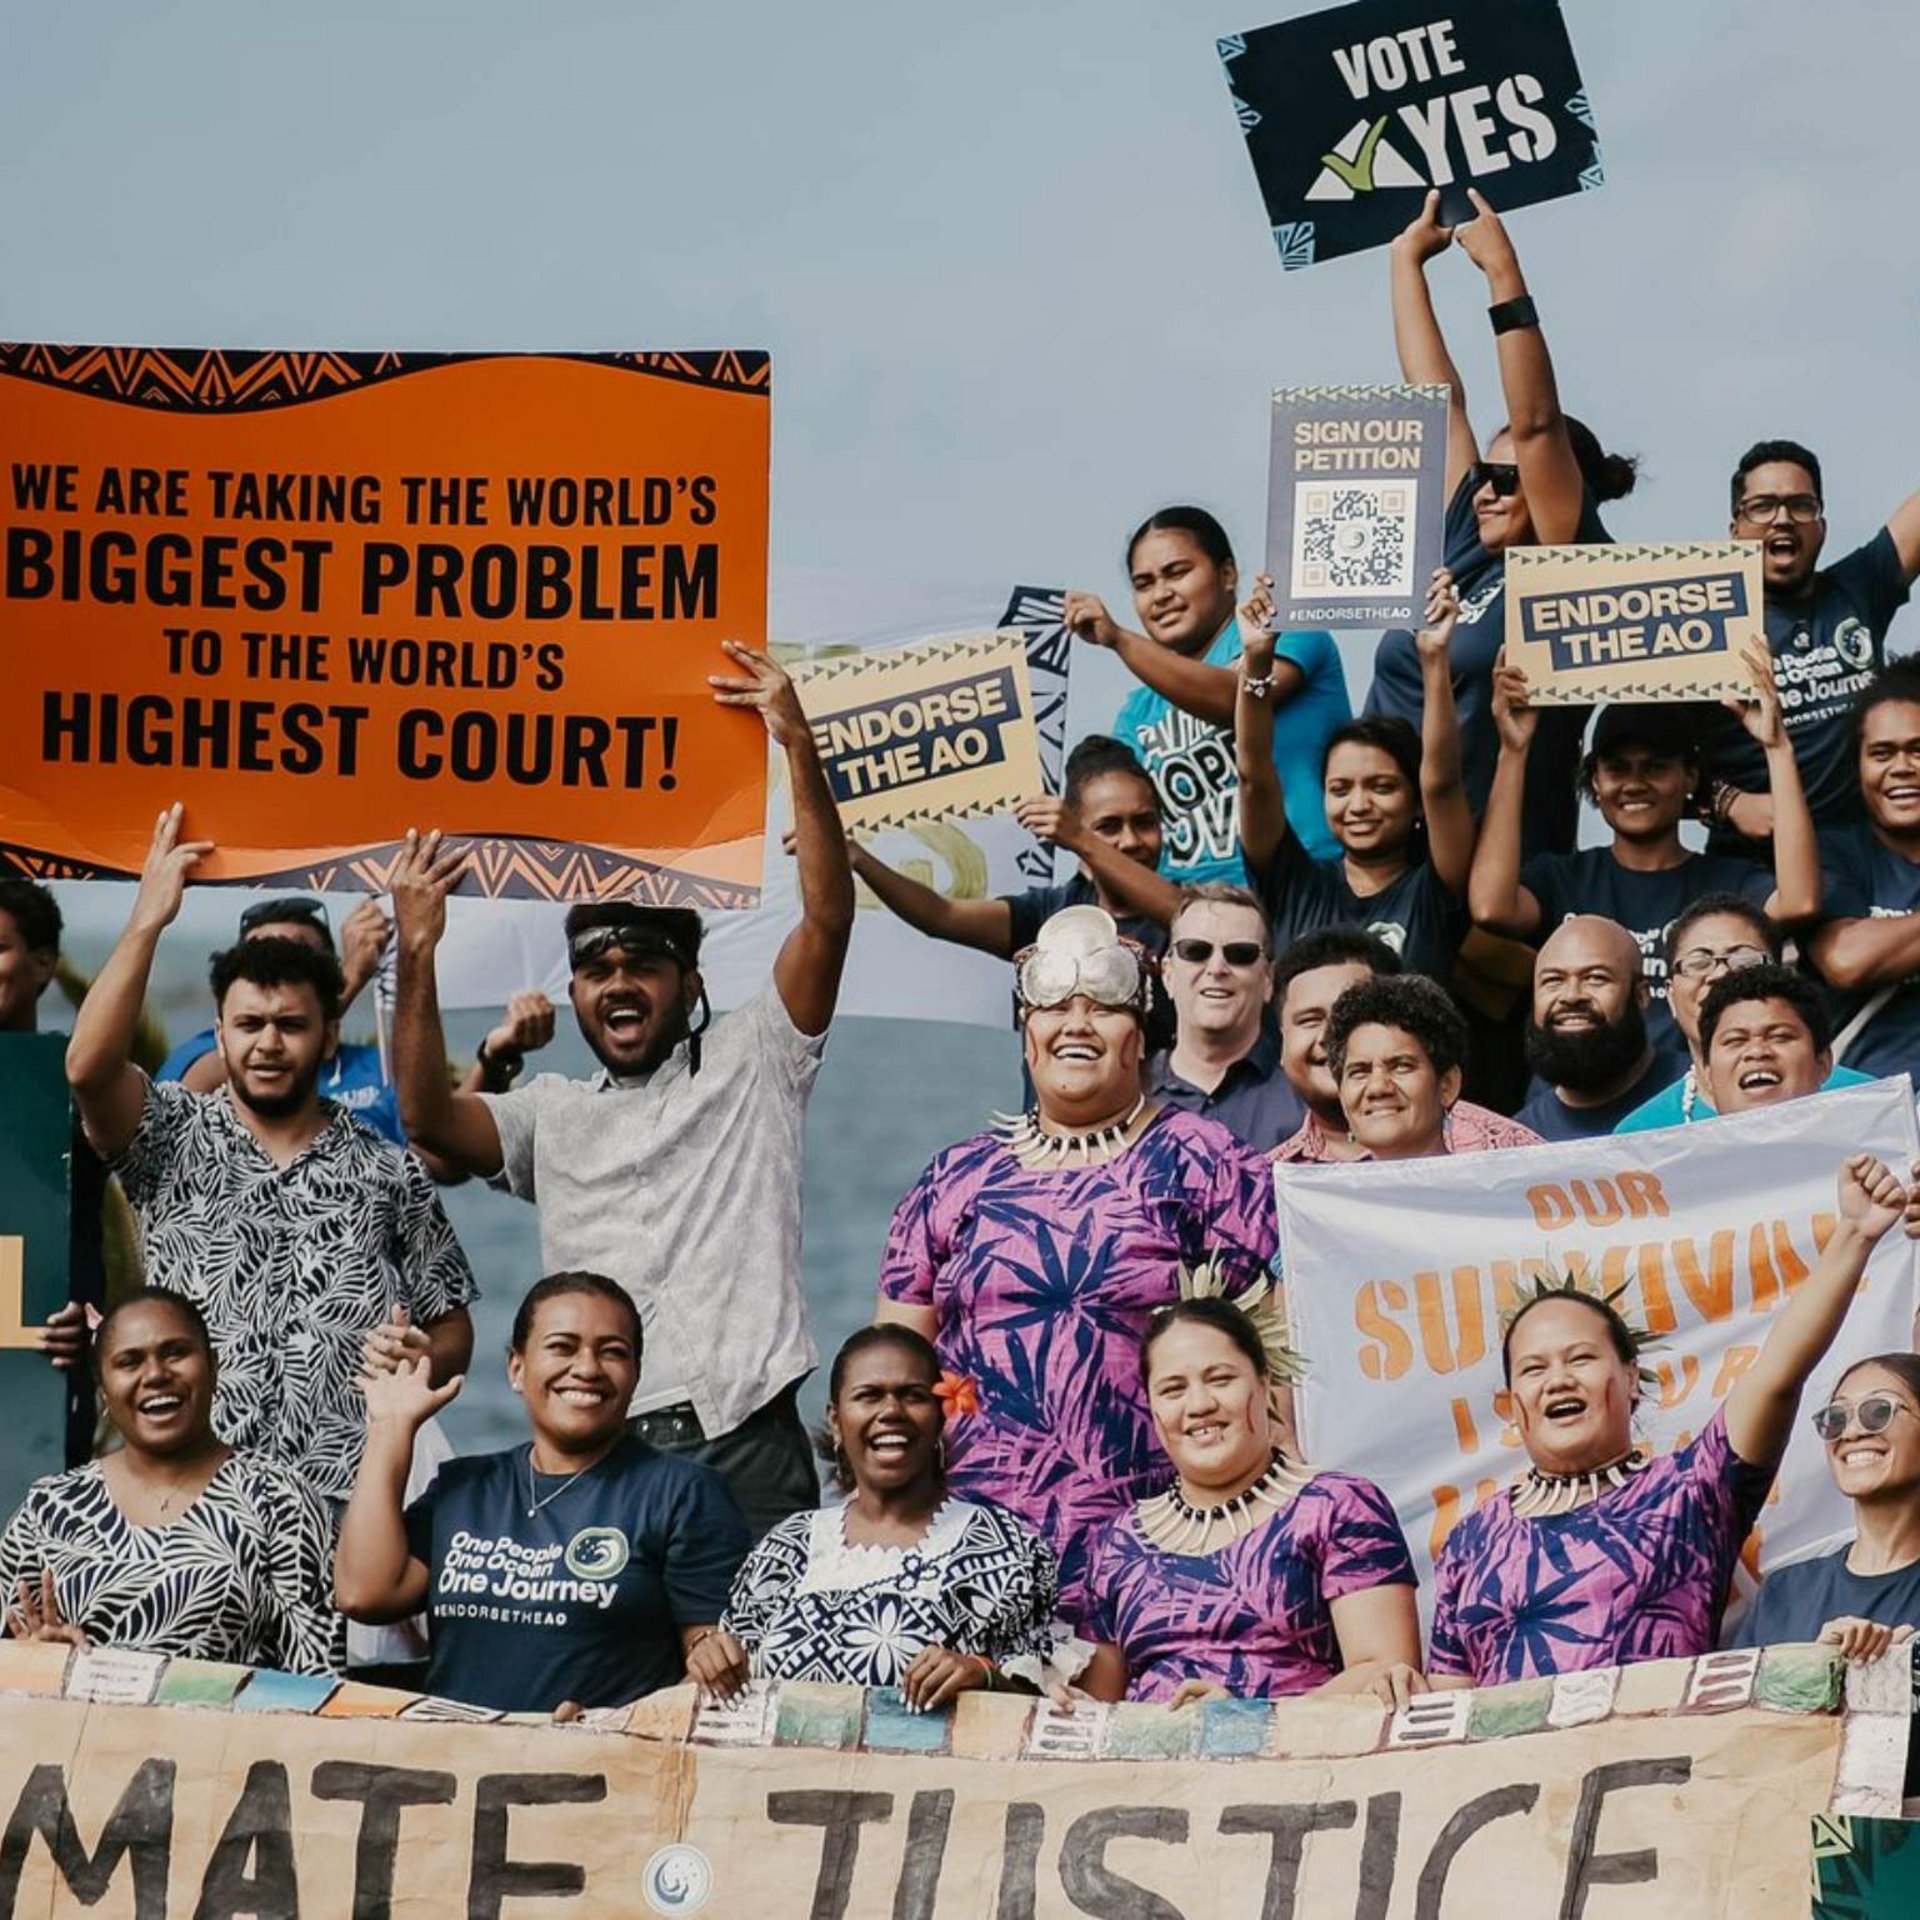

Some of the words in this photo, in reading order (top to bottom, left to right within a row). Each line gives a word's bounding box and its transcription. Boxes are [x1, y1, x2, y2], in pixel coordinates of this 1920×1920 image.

[1332, 19, 1466, 100] VOTE
[1397, 74, 1558, 188] YES
[1294, 420, 1361, 445] SIGN
[1363, 420, 1423, 442] OUR
[1294, 447, 1421, 471] PETITION
[11, 462, 80, 513] WE
[94, 466, 190, 518] ARE
[207, 471, 381, 524] TAKING
[400, 477, 489, 526] THE
[5, 526, 333, 613] BIGGEST
[361, 542, 719, 620] PROBLEM
[1289, 606, 1412, 622] #ENDORSETHEAO
[1532, 579, 1736, 633] ENDORSE
[162, 628, 222, 676] TO
[240, 632, 330, 682] THE
[1561, 628, 1648, 665] THE
[1652, 619, 1714, 656] AO
[41, 690, 370, 776] HIGHEST
[397, 708, 679, 791] COURT!
[837, 743, 925, 794] THE
[930, 727, 990, 775] AO
[1525, 1170, 1670, 1231] OUR
[444, 1549, 486, 1570] One
[487, 1553, 554, 1578] Ocean
[451, 1531, 493, 1554] One
[494, 1536, 563, 1565] People
[438, 1568, 488, 1595] One
[492, 1573, 619, 1609] Journey
